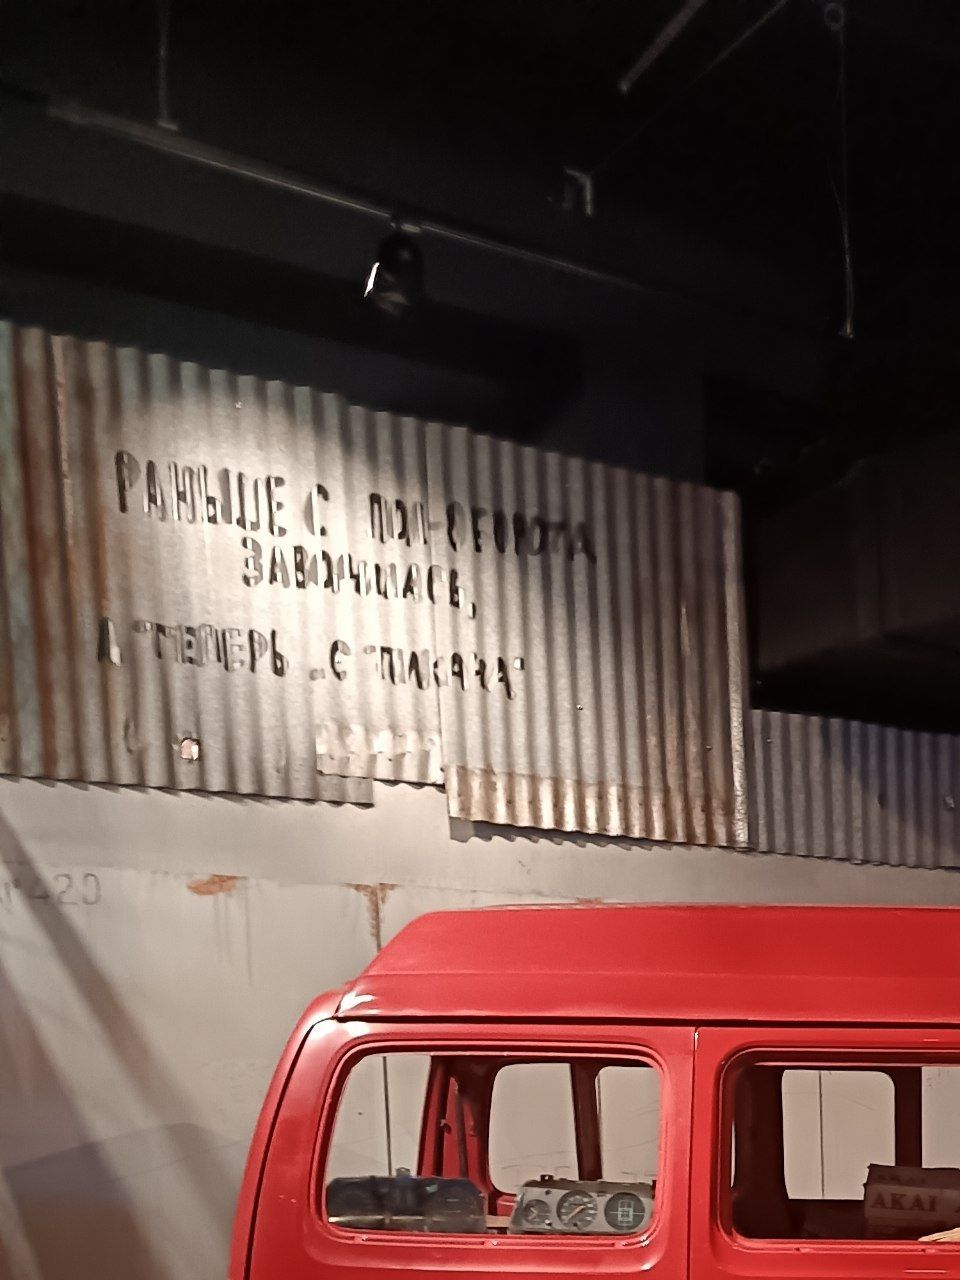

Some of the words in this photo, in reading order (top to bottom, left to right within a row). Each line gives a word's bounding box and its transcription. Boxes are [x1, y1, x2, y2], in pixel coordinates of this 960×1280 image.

[115, 450, 287, 537] РАНЬШЕ
[303, 483, 330, 536] С
[131, 619, 290, 678] ТЕПЕРЬ
[870, 1191, 938, 1212] AKAI
